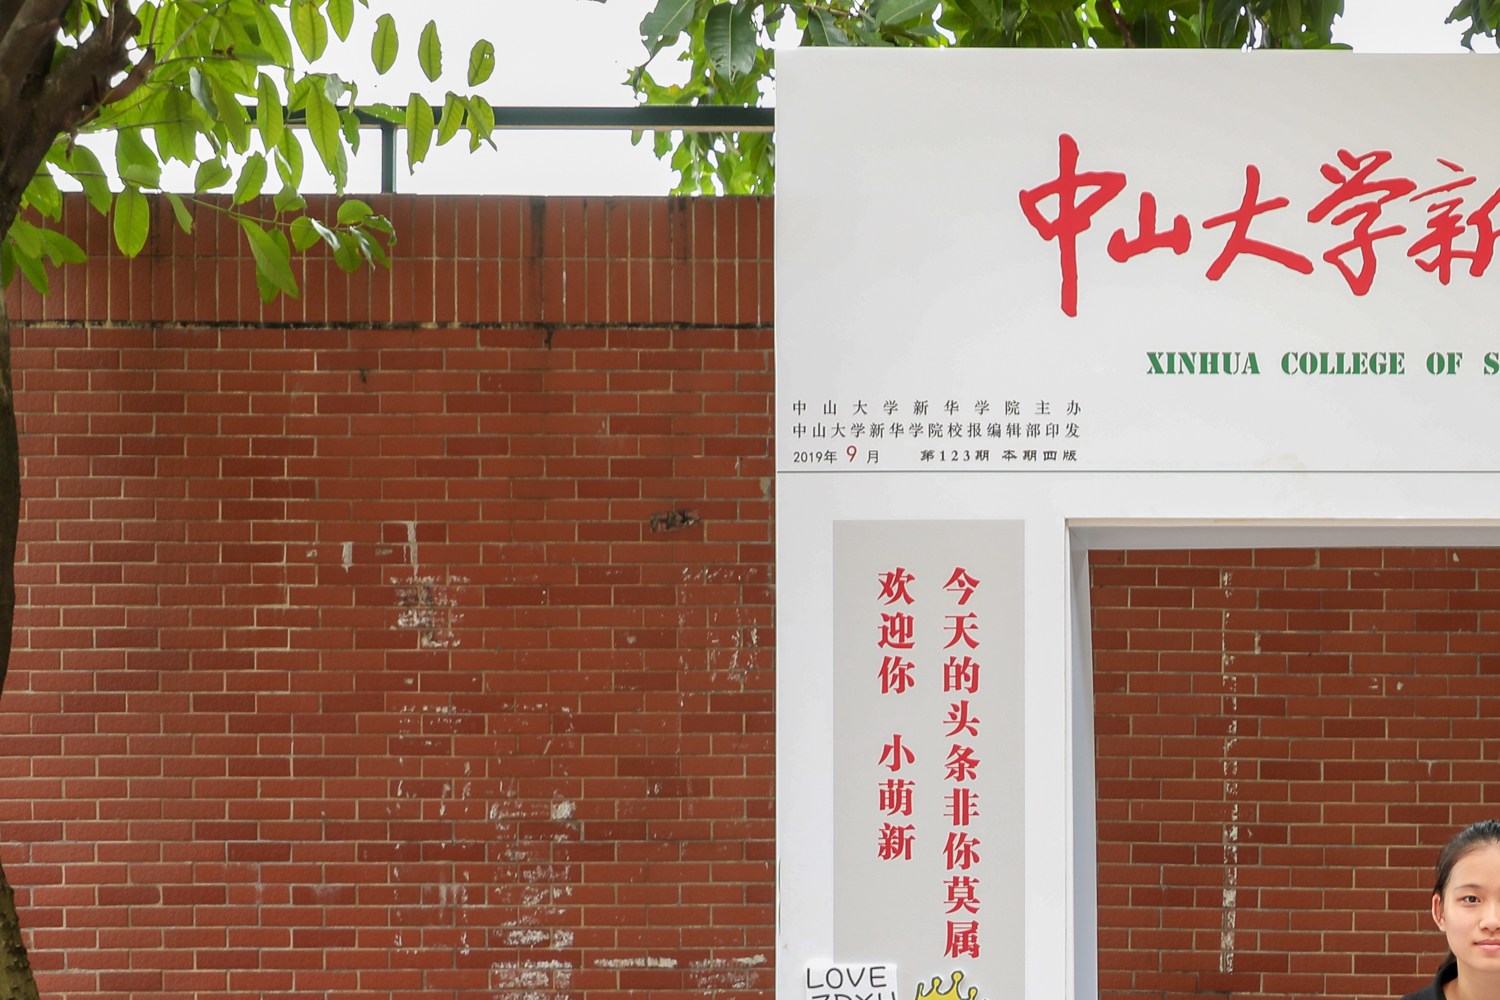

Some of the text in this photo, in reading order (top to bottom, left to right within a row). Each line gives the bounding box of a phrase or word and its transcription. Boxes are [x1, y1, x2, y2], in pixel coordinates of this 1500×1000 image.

[1147, 352, 1260, 374] XINHUA
[1281, 352, 1404, 374] COLLEGE
[1427, 352, 1462, 375] OF
[793, 400, 1081, 415] 中山大学新华学院主办
[793, 423, 1079, 438] 中山大学新华学院校报编辑部印发
[794, 450, 837, 464] 2019年
[847, 446, 857, 462] 9
[867, 451, 878, 463] 月
[1002, 450, 1077, 461] 本期四版
[878, 567, 915, 860] 欢迎你 小萌新
[943, 567, 980, 958] 今天的头条非你莫属
[806, 966, 887, 990] LOVE
